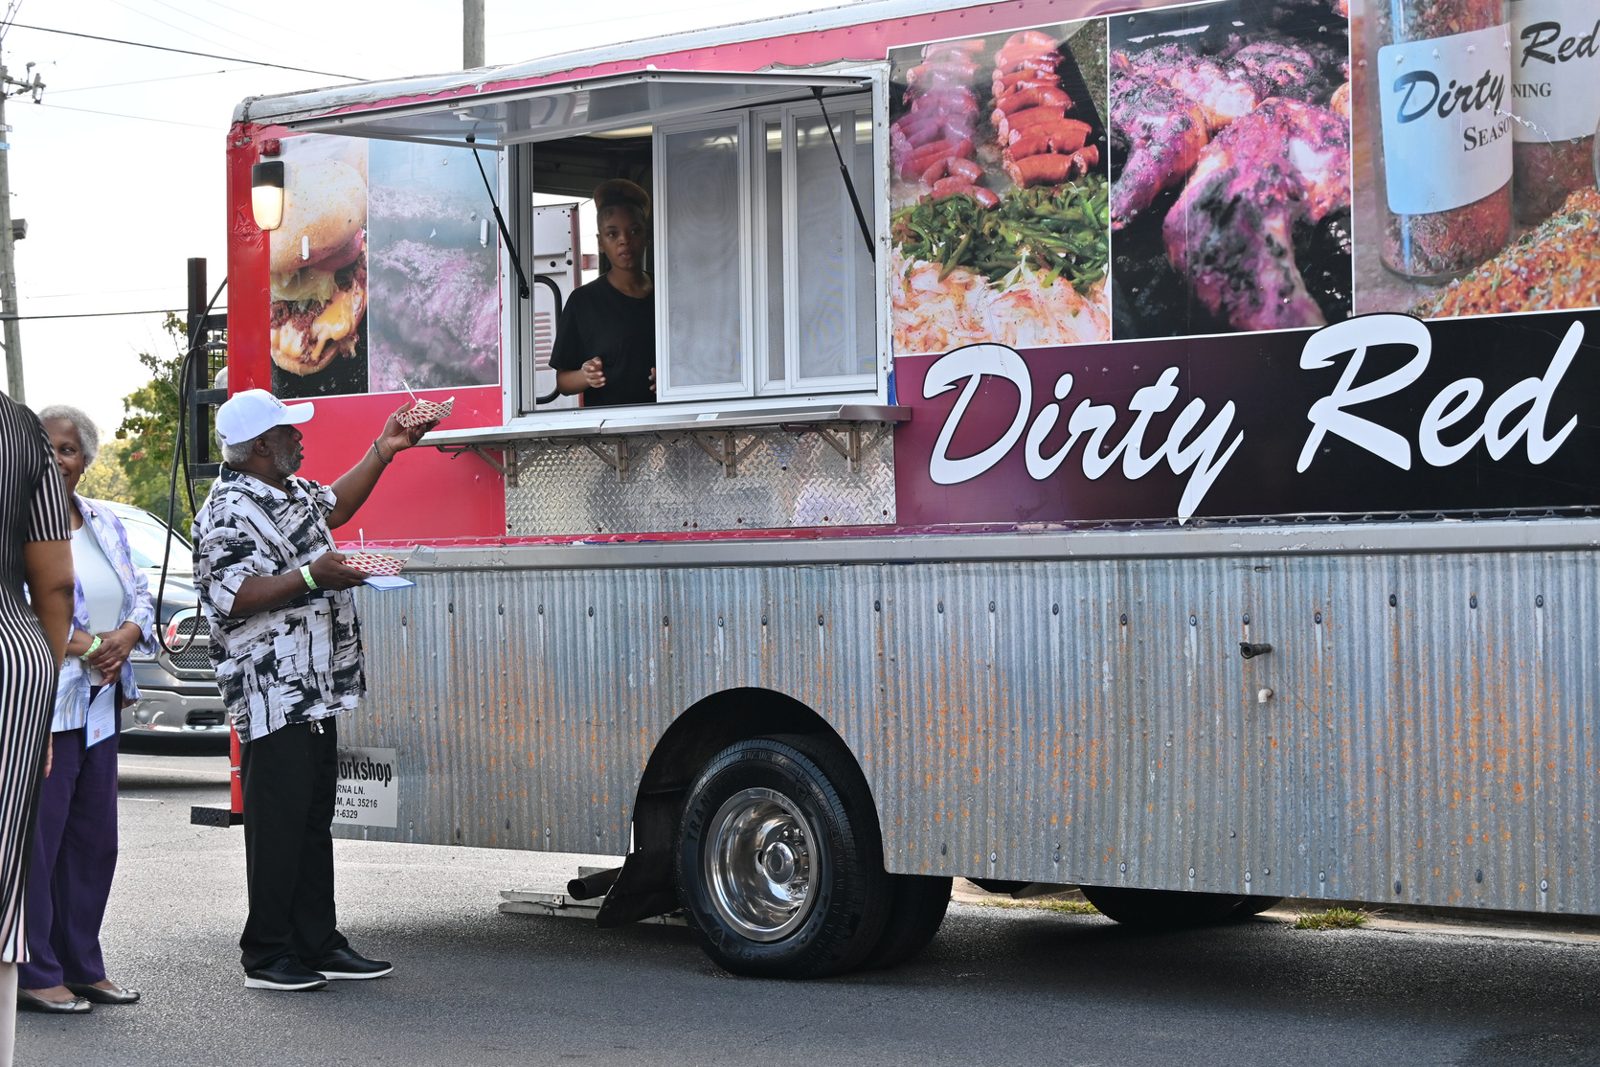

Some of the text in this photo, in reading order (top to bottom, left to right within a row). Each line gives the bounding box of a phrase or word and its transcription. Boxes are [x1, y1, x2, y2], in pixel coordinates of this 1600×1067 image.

[1520, 21, 1600, 68] Red
[1393, 69, 1504, 124] Dirty
[1512, 82, 1552, 98] NING
[922, 313, 1585, 525] Dirty Red
[337, 757, 392, 787] orkshop
[336, 785, 352, 793] RNA
[336, 809, 358, 819] 1-6329
[346, 798, 355, 806] AL
[358, 798, 378, 808] 35216
